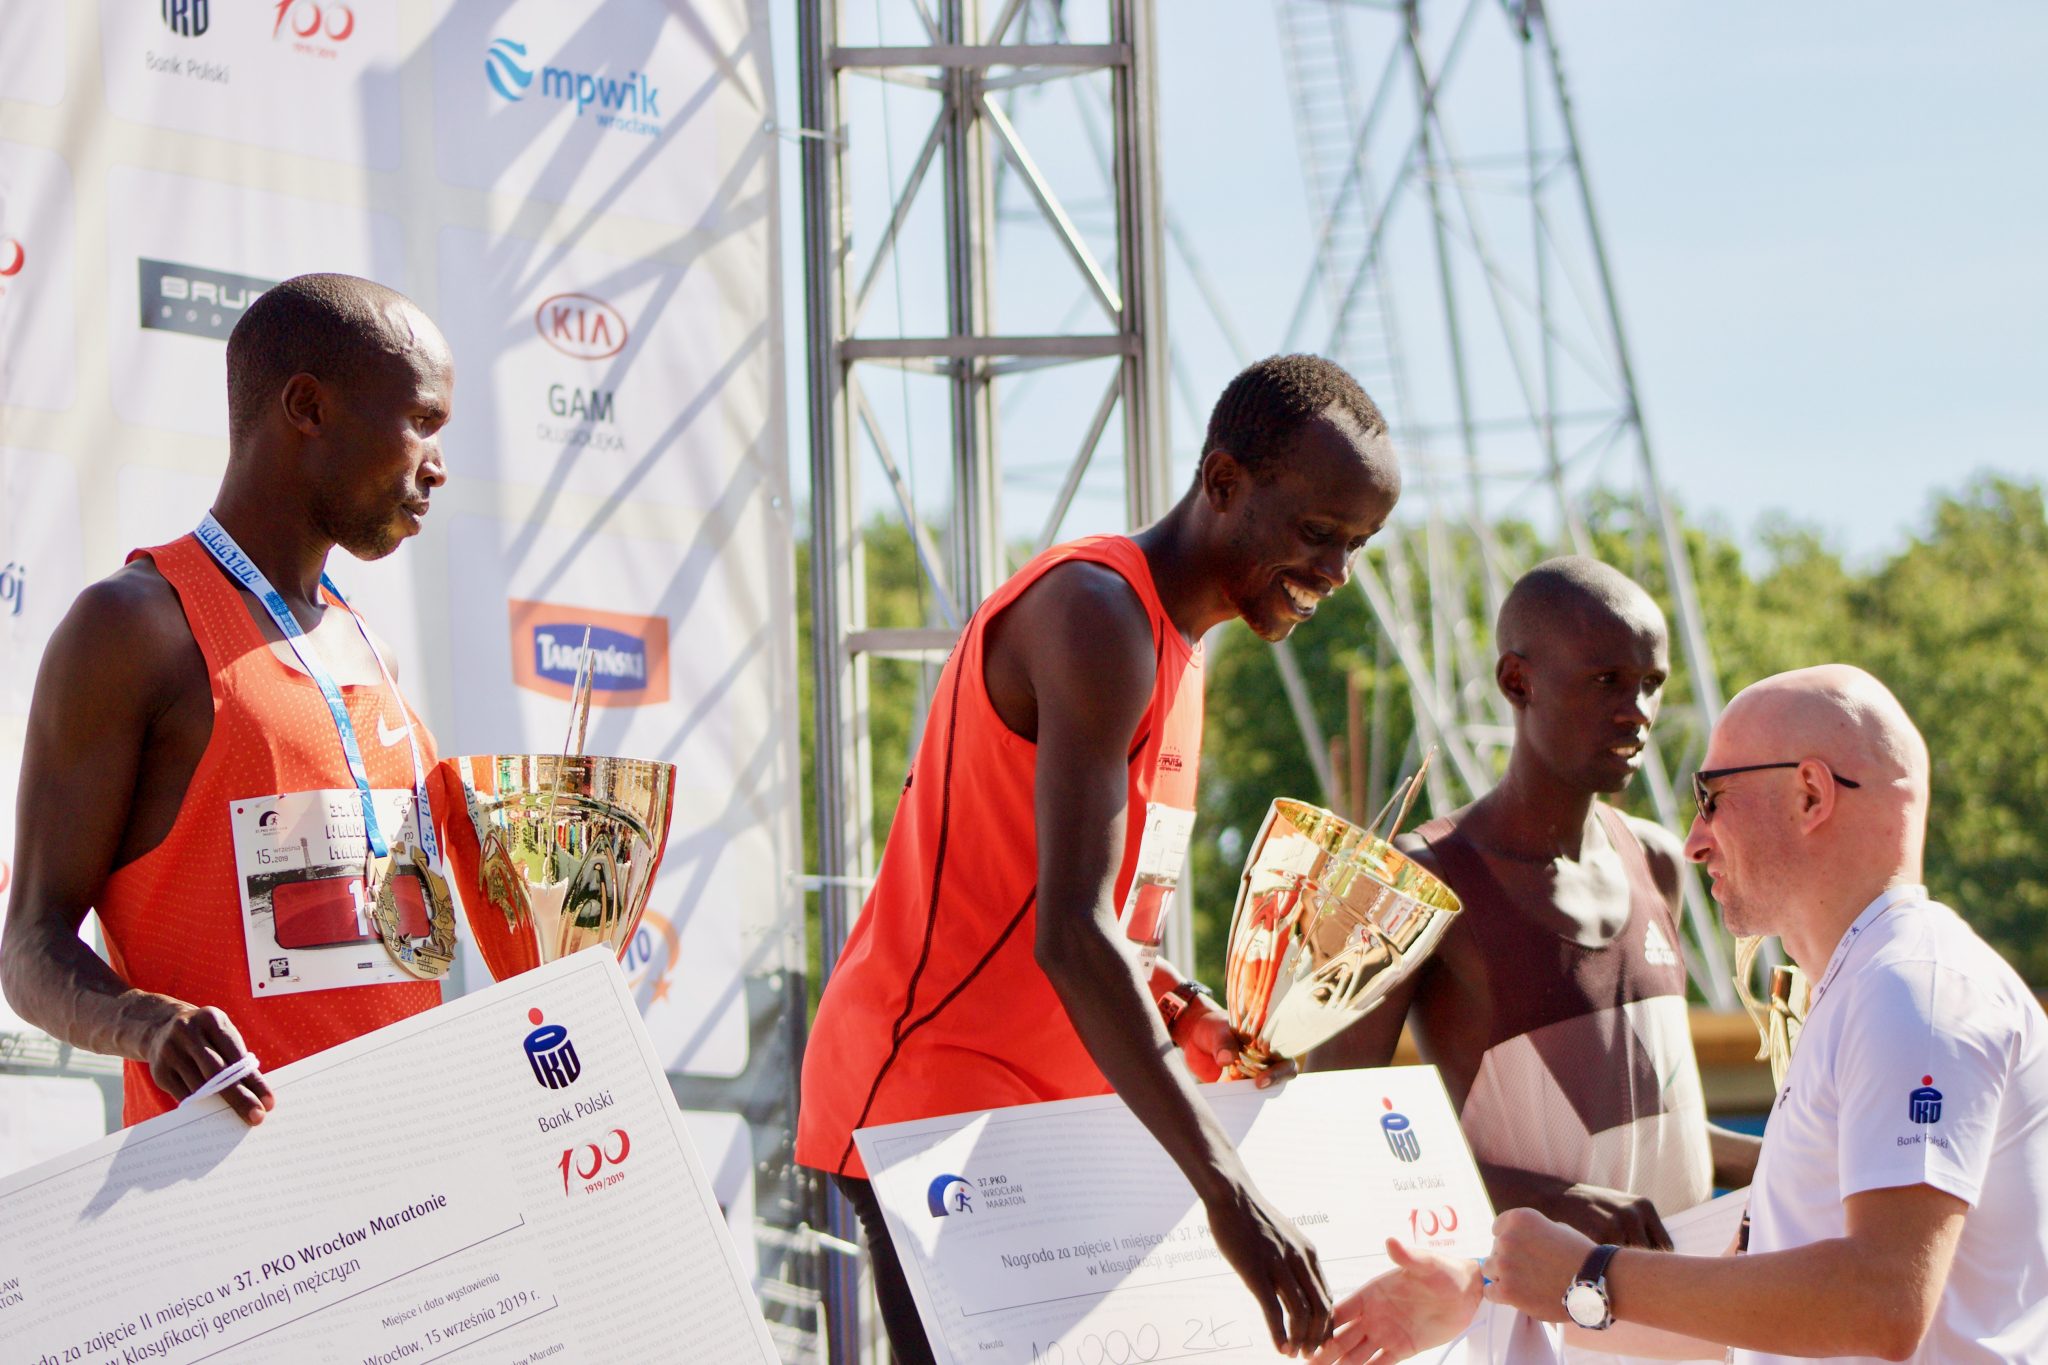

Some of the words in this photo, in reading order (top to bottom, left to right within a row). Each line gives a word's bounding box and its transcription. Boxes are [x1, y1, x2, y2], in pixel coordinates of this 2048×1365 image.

[146, 51, 182, 76] Bank
[187, 59, 230, 84] Polski
[543, 66, 660, 117] mpwik
[161, 275, 262, 310] BRU
[552, 305, 612, 347] KIA
[548, 383, 614, 424] GAM
[538, 1108, 574, 1133] Bank
[574, 1090, 614, 1118] Polski
[1897, 1134, 1921, 1147] Bank
[558, 1129, 630, 1198] 100
[585, 1172, 625, 1195] 1919/2019
[986, 1195, 1026, 1208] MARATON
[1392, 1177, 1417, 1191] Bank
[1409, 1205, 1457, 1244] 100
[1001, 1248, 1055, 1270] Nagroda
[1057, 1248, 1071, 1259] za
[1072, 1239, 1112, 1259] zajęcie
[1121, 1233, 1163, 1251] miejsca
[1086, 1264, 1098, 1276] w
[62, 1346, 81, 1363] za
[83, 1322, 138, 1354] zajęcie
[155, 1291, 215, 1325] miejsca
[216, 1283, 231, 1298] w
[233, 1271, 260, 1292] 37.
[261, 1254, 296, 1280] PKO
[298, 1230, 367, 1265] Wrocław
[369, 1194, 448, 1236] Maratonie
[122, 1317, 209, 1365] klasyfikacji
[213, 1284, 292, 1333] generalnej
[293, 1258, 361, 1294] mężczyzn
[381, 1308, 417, 1329] Miejsce
[424, 1297, 445, 1312] data
[445, 1272, 500, 1304] wystawienia
[424, 1329, 441, 1346] 15
[443, 1308, 496, 1338] września
[497, 1291, 528, 1315] 2019
[529, 1342, 565, 1363] Maraton
